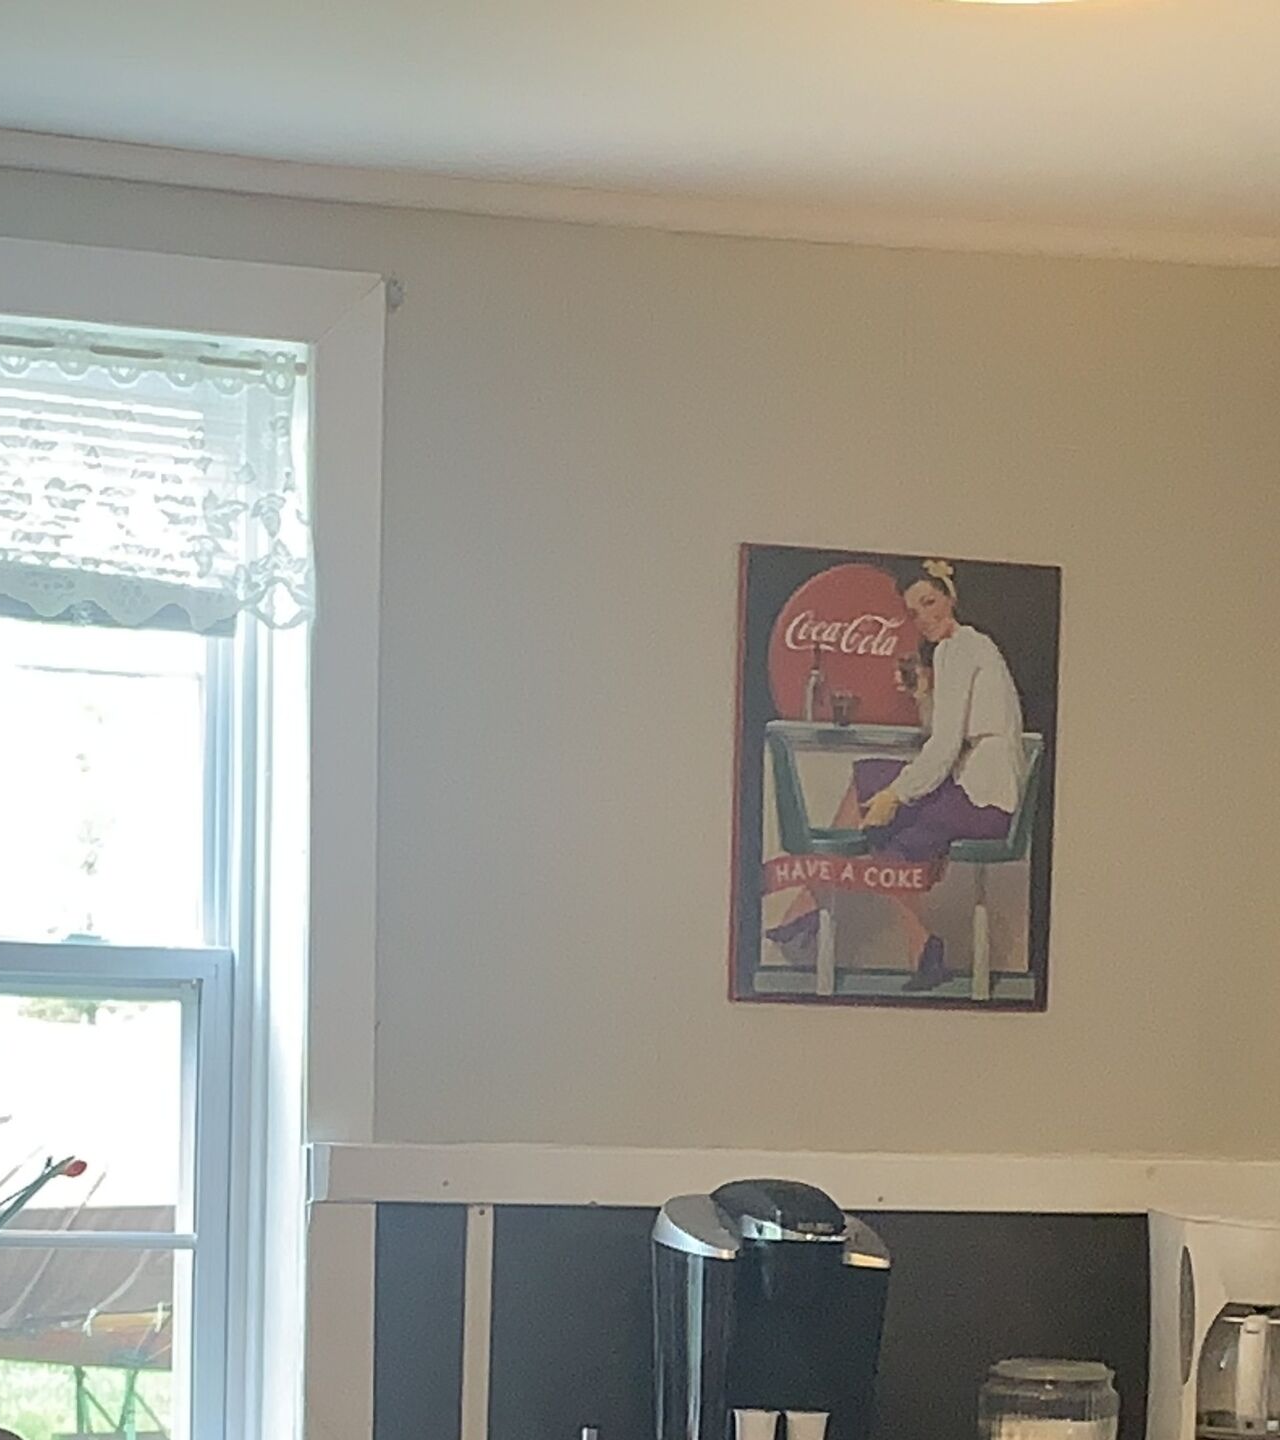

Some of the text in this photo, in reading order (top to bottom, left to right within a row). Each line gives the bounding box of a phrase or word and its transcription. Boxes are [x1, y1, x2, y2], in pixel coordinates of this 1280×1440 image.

[776, 859, 923, 888] HAVE A COKE
